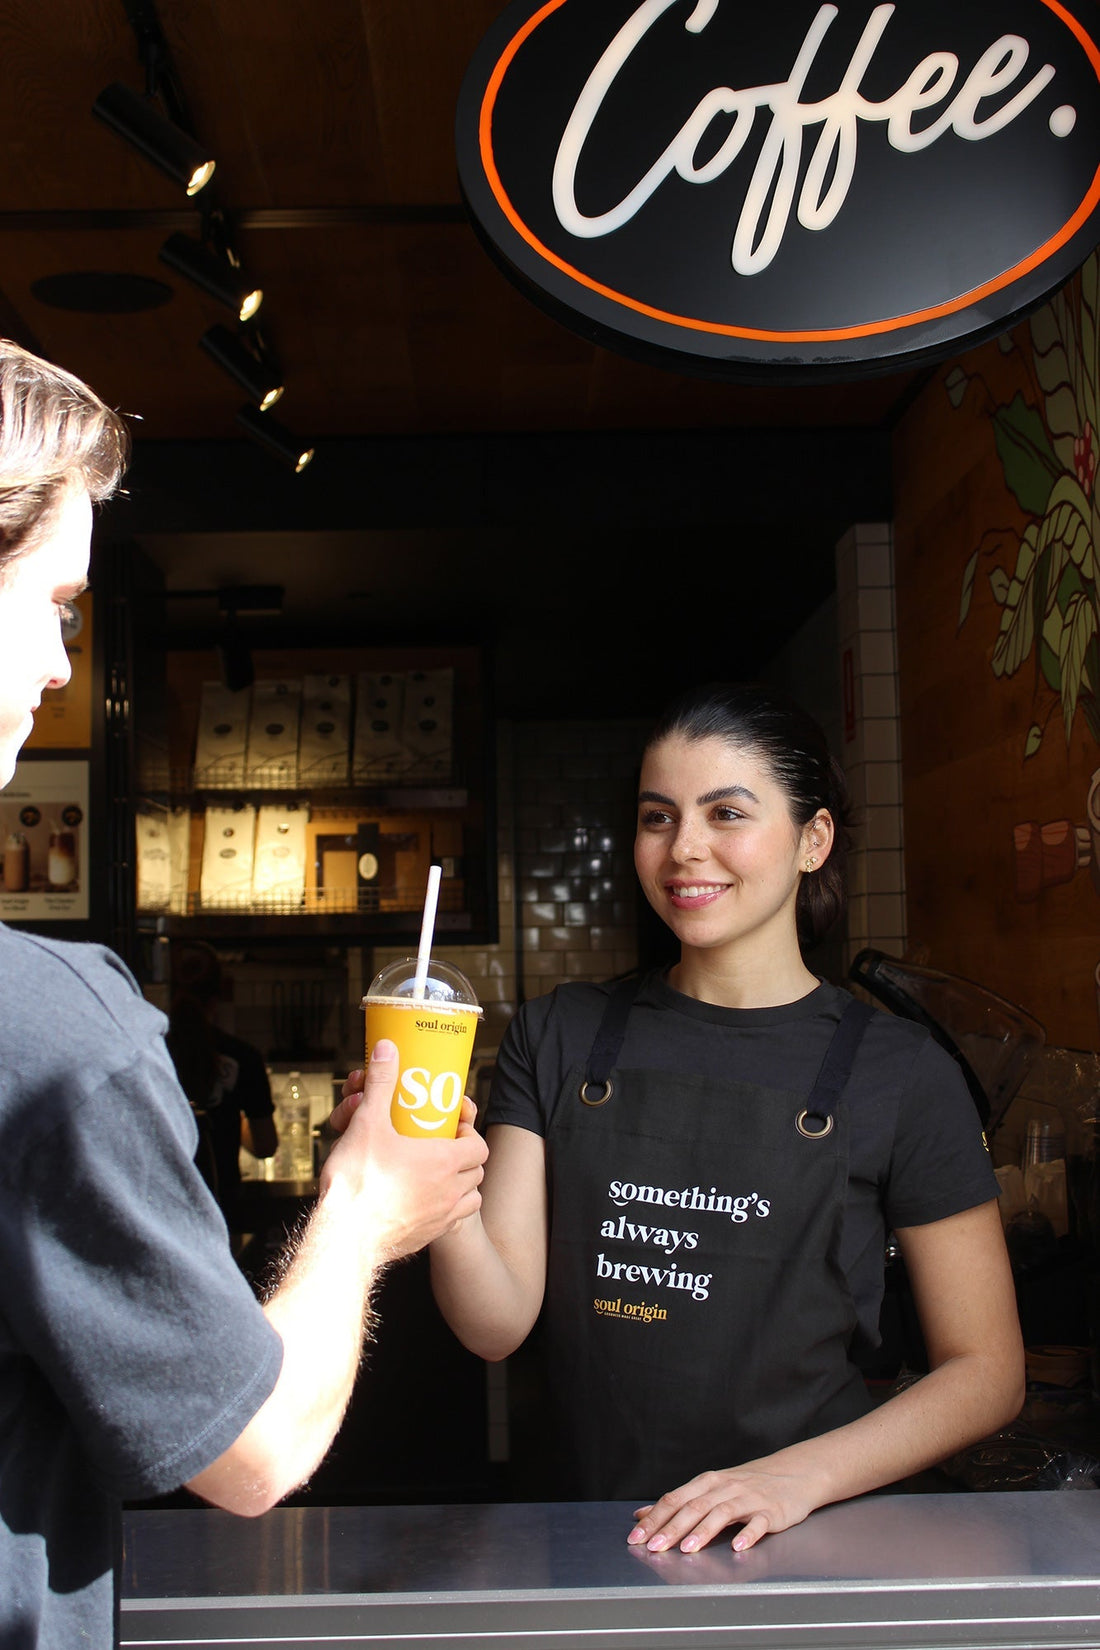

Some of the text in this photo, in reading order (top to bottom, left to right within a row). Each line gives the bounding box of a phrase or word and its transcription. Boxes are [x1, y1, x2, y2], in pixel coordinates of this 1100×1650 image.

[415, 1019, 467, 1036] soul origin
[608, 1180, 771, 1224] something's
[600, 1215, 699, 1255] always
[596, 1253, 713, 1301] brewing
[594, 1298, 668, 1323] soul origin
